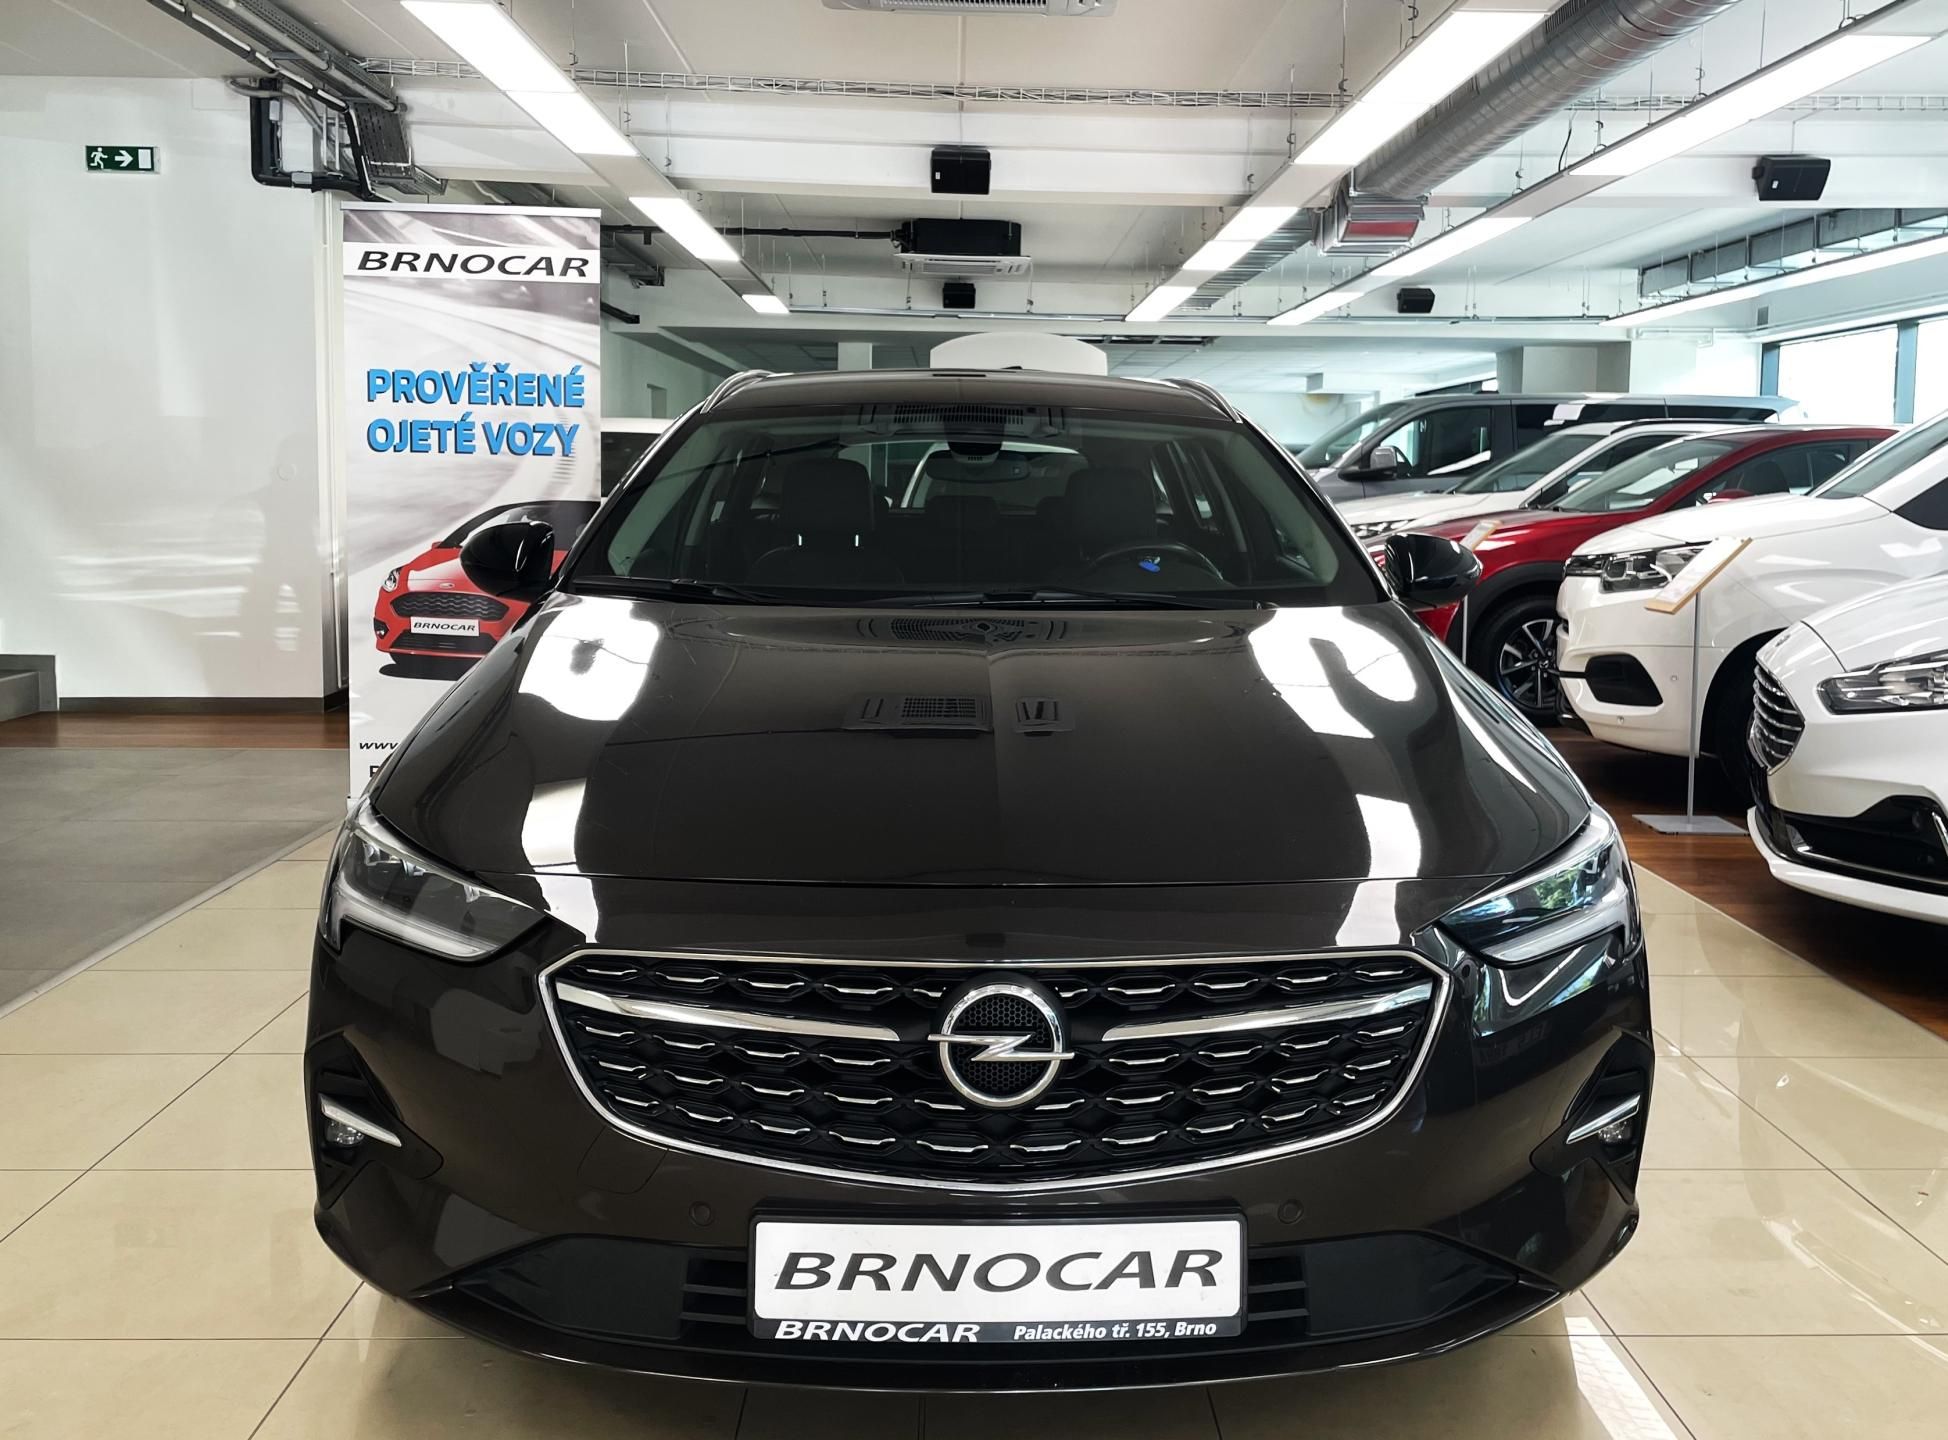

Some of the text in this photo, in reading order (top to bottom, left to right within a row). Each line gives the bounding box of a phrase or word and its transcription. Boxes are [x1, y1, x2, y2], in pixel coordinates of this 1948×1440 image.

[357, 250, 590, 277] BRNOCAR
[366, 362, 585, 408] PROVĚŘENÉ
[366, 411, 580, 457] OJETÉ VOZY
[413, 622, 476, 632] BRNOCAR
[774, 1249, 1223, 1292] BRNOCAR
[774, 1320, 981, 1343] BRNOCAR
[1013, 1321, 1217, 1341] Palackého tř. 155, Brno
